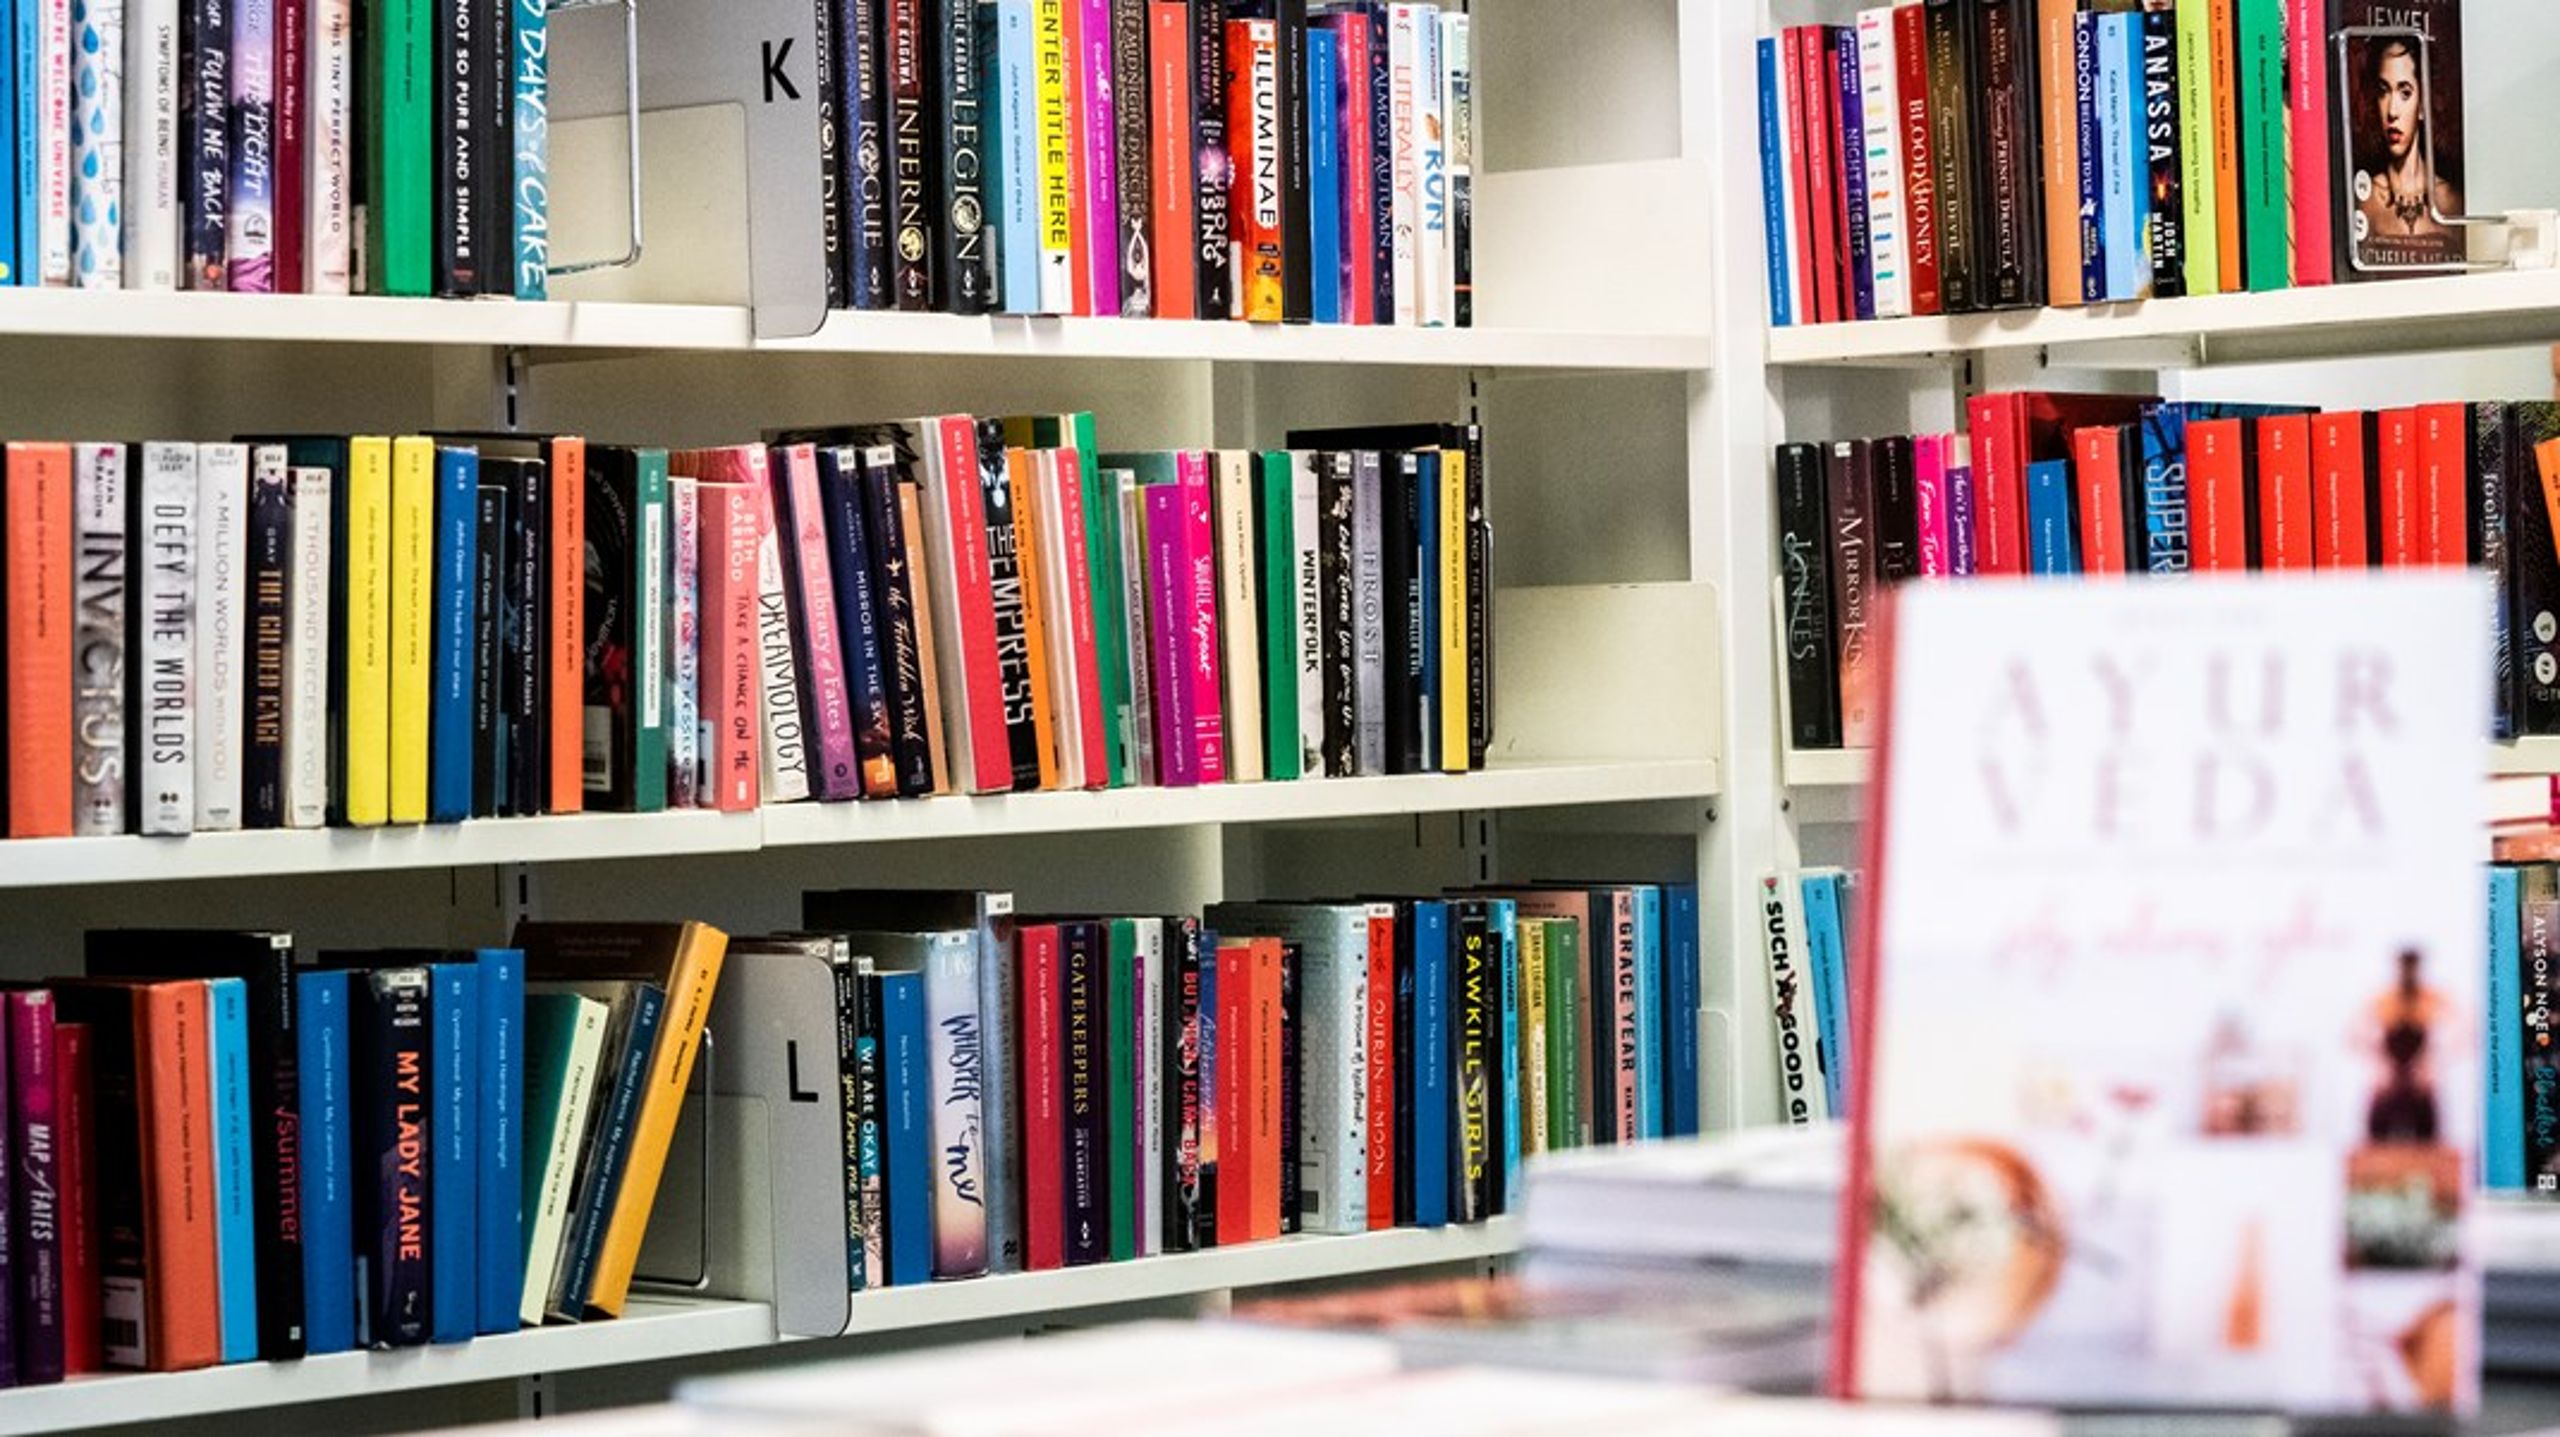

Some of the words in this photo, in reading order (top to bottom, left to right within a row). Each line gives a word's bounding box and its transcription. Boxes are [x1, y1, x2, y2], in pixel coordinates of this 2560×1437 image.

[157, 25, 169, 94] SYMPTOMS
[332, 56, 341, 91] TINY
[456, 49, 469, 75] SO
[761, 38, 801, 103] K
[1042, 1, 1059, 84] ENTER
[54, 55, 65, 130] WELCOME
[158, 98, 169, 113] OF
[202, 47, 224, 121] FOLLOW
[457, 81, 469, 130] PURE
[2145, 35, 2171, 162] ANASSA
[157, 118, 169, 156] BEING
[203, 128, 223, 159] ME
[331, 99, 341, 167] PERFECT
[457, 136, 469, 179] AND
[1047, 97, 1062, 164] TITLE
[1256, 50, 1275, 224] ILLUMINAE
[53, 141, 63, 217] UNIVERSE
[203, 168, 223, 231] BACK
[331, 174, 341, 233] WORLD
[1049, 176, 1066, 244] HERE
[456, 186, 469, 258] SIMPLE
[519, 176, 547, 287] CAKE
[2152, 212, 2164, 269] MARTIN
[154, 505, 186, 573] DEFY
[215, 506, 229, 591] MILLION
[153, 593, 185, 641] THE
[856, 570, 871, 635] MIRROR
[866, 665, 881, 695] THE
[1303, 550, 1319, 672] WINTERFOLK
[153, 659, 185, 763] WORLDS
[736, 717, 748, 740] ON
[1979, 647, 2398, 742] AYUR
[735, 750, 749, 771] ME
[1979, 749, 2386, 840] VEDA
[1619, 922, 1633, 1004] GRACE
[2534, 915, 2547, 987] ALYSON
[1466, 935, 1482, 1075] SAWKILL
[1767, 902, 1787, 971] SUCH
[1781, 1014, 1803, 1091] GOOD
[860, 1046, 873, 1074] WE
[1071, 953, 1088, 1115] GATEKEEPERS
[1621, 1012, 1634, 1071] YEAR
[397, 1050, 419, 1093] MY
[787, 1040, 819, 1102] L
[862, 1079, 875, 1113] ARE
[398, 1103, 419, 1177] LADY
[862, 1120, 876, 1169] OKAY
[1374, 1110, 1385, 1175] MOON
[1467, 1089, 1482, 1180] GIRLS
[400, 1188, 421, 1261] JANE
